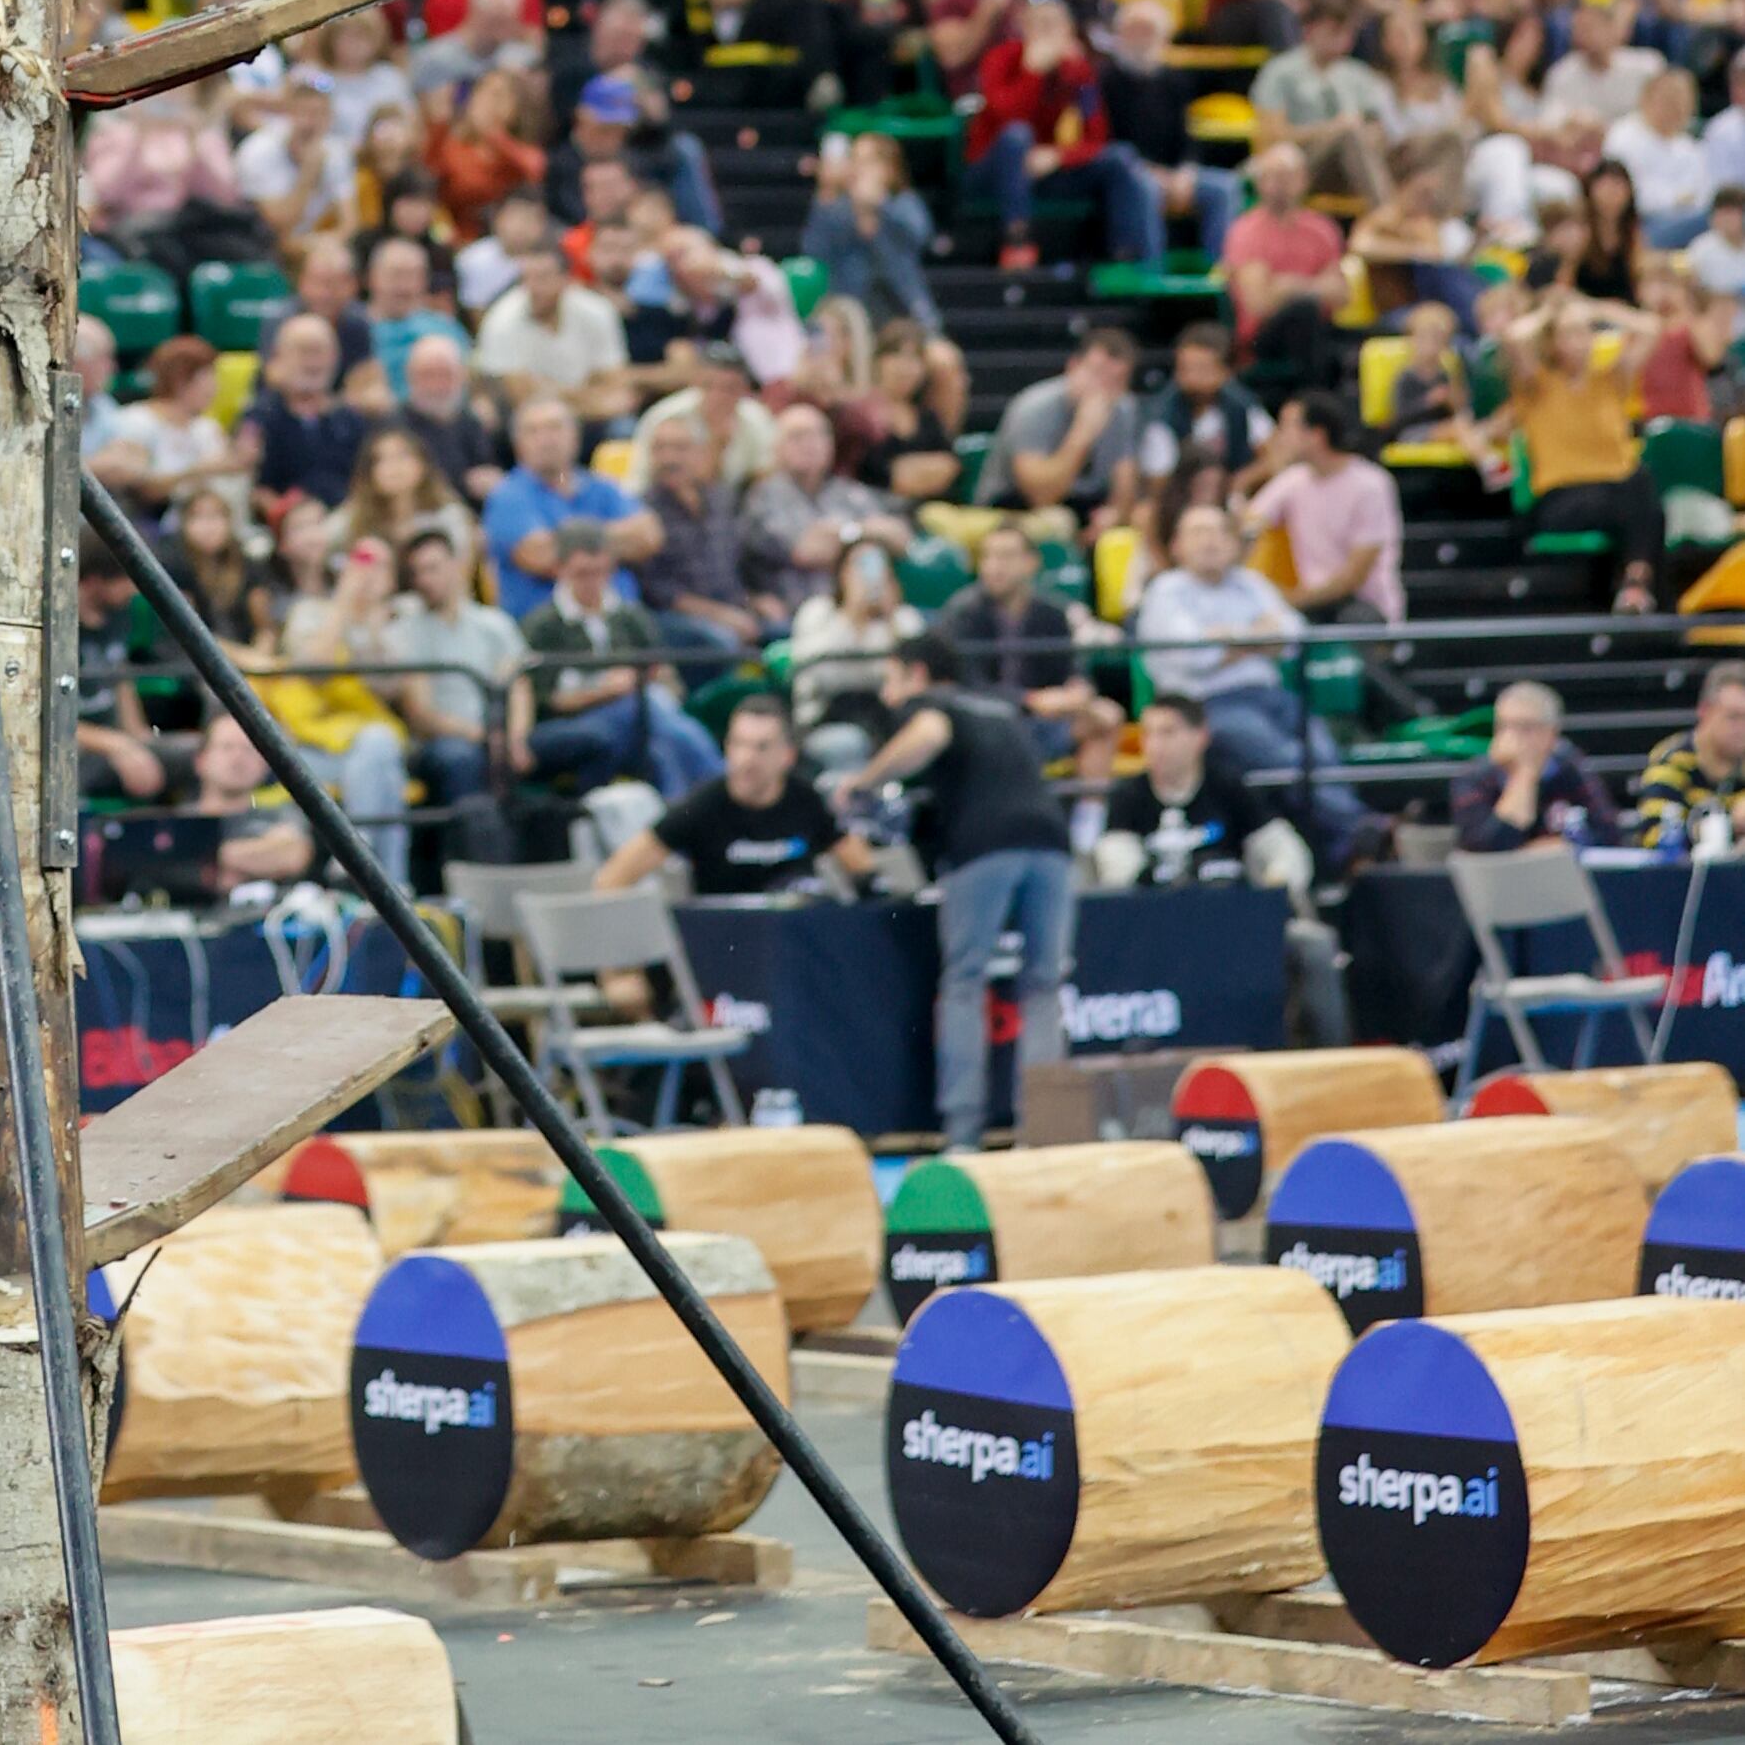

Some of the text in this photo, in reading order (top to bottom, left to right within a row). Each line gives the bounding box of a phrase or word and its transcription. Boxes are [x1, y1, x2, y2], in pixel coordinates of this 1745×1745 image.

[364, 1367, 498, 1436] sherpa.ai
[902, 1408, 1056, 1484] sherpa.ai
[1338, 1452, 1501, 1526] sherpa.ai
